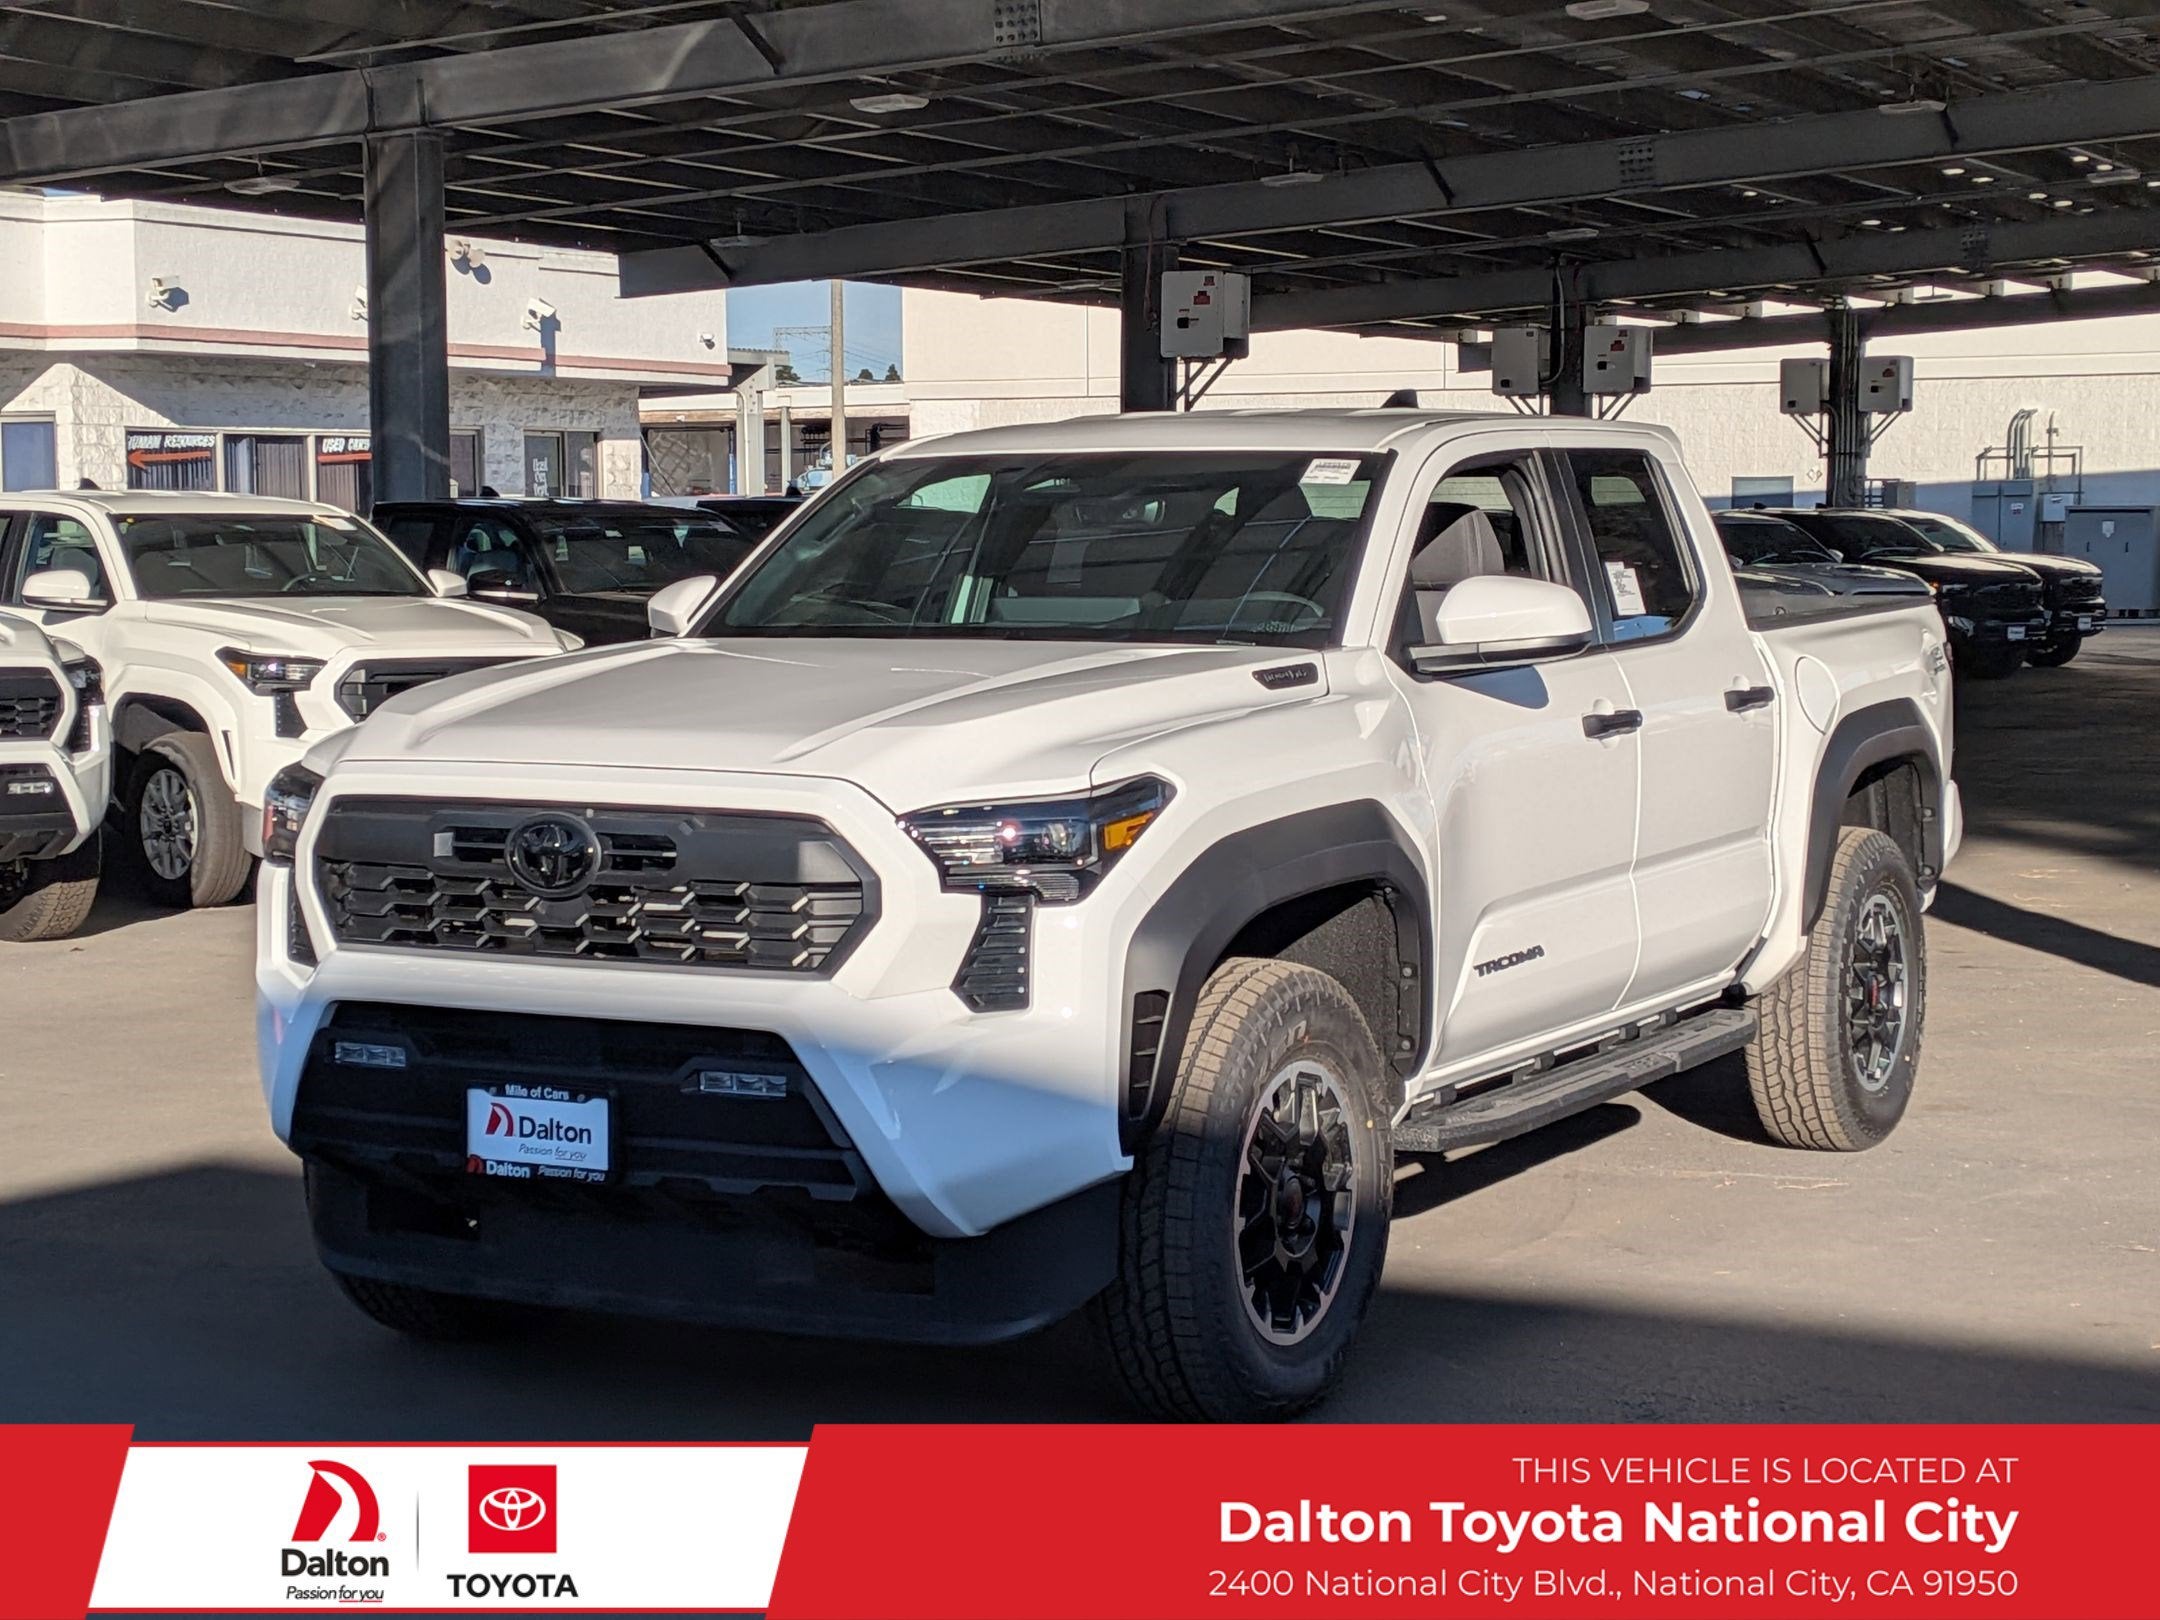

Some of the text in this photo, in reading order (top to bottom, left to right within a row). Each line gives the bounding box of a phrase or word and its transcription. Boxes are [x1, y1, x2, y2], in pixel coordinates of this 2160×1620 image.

[322, 437, 346, 453] USED
[1473, 945, 1545, 977] TACOMA
[505, 1084, 570, 1100] Mile of Cars
[518, 1116, 592, 1144] Dalton
[518, 1143, 588, 1161] Passion for you
[486, 1161, 606, 1183] Dalton Passion for you
